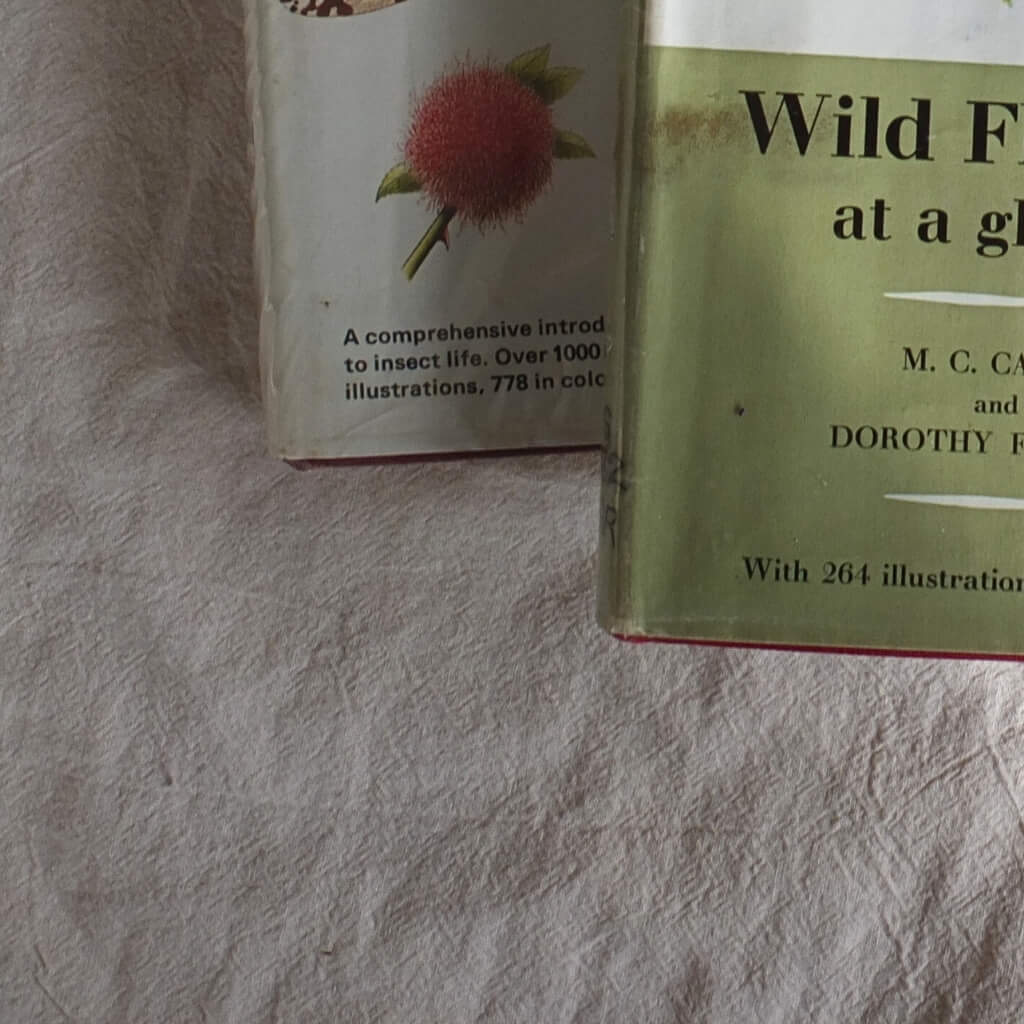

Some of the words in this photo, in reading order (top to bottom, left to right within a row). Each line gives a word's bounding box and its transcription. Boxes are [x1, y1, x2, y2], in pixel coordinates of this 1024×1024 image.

[739, 90, 934, 161] Wild
[833, 199, 891, 241] at
[918, 209, 951, 244] a
[344, 329, 359, 346] A
[365, 321, 531, 346] comprehensive
[538, 315, 605, 336] introd
[344, 358, 367, 373] to
[374, 354, 440, 371] insect
[447, 349, 487, 368] life.
[495, 348, 548, 366] Over
[553, 342, 601, 363] 1000
[903, 347, 935, 372] M.
[950, 350, 976, 374] C.
[346, 379, 483, 400] illustrations,
[490, 374, 528, 392] 778
[535, 372, 554, 390] in
[974, 395, 1017, 414] and
[830, 426, 993, 454] DOROTHY
[743, 557, 808, 582] With
[822, 562, 870, 586] 264
